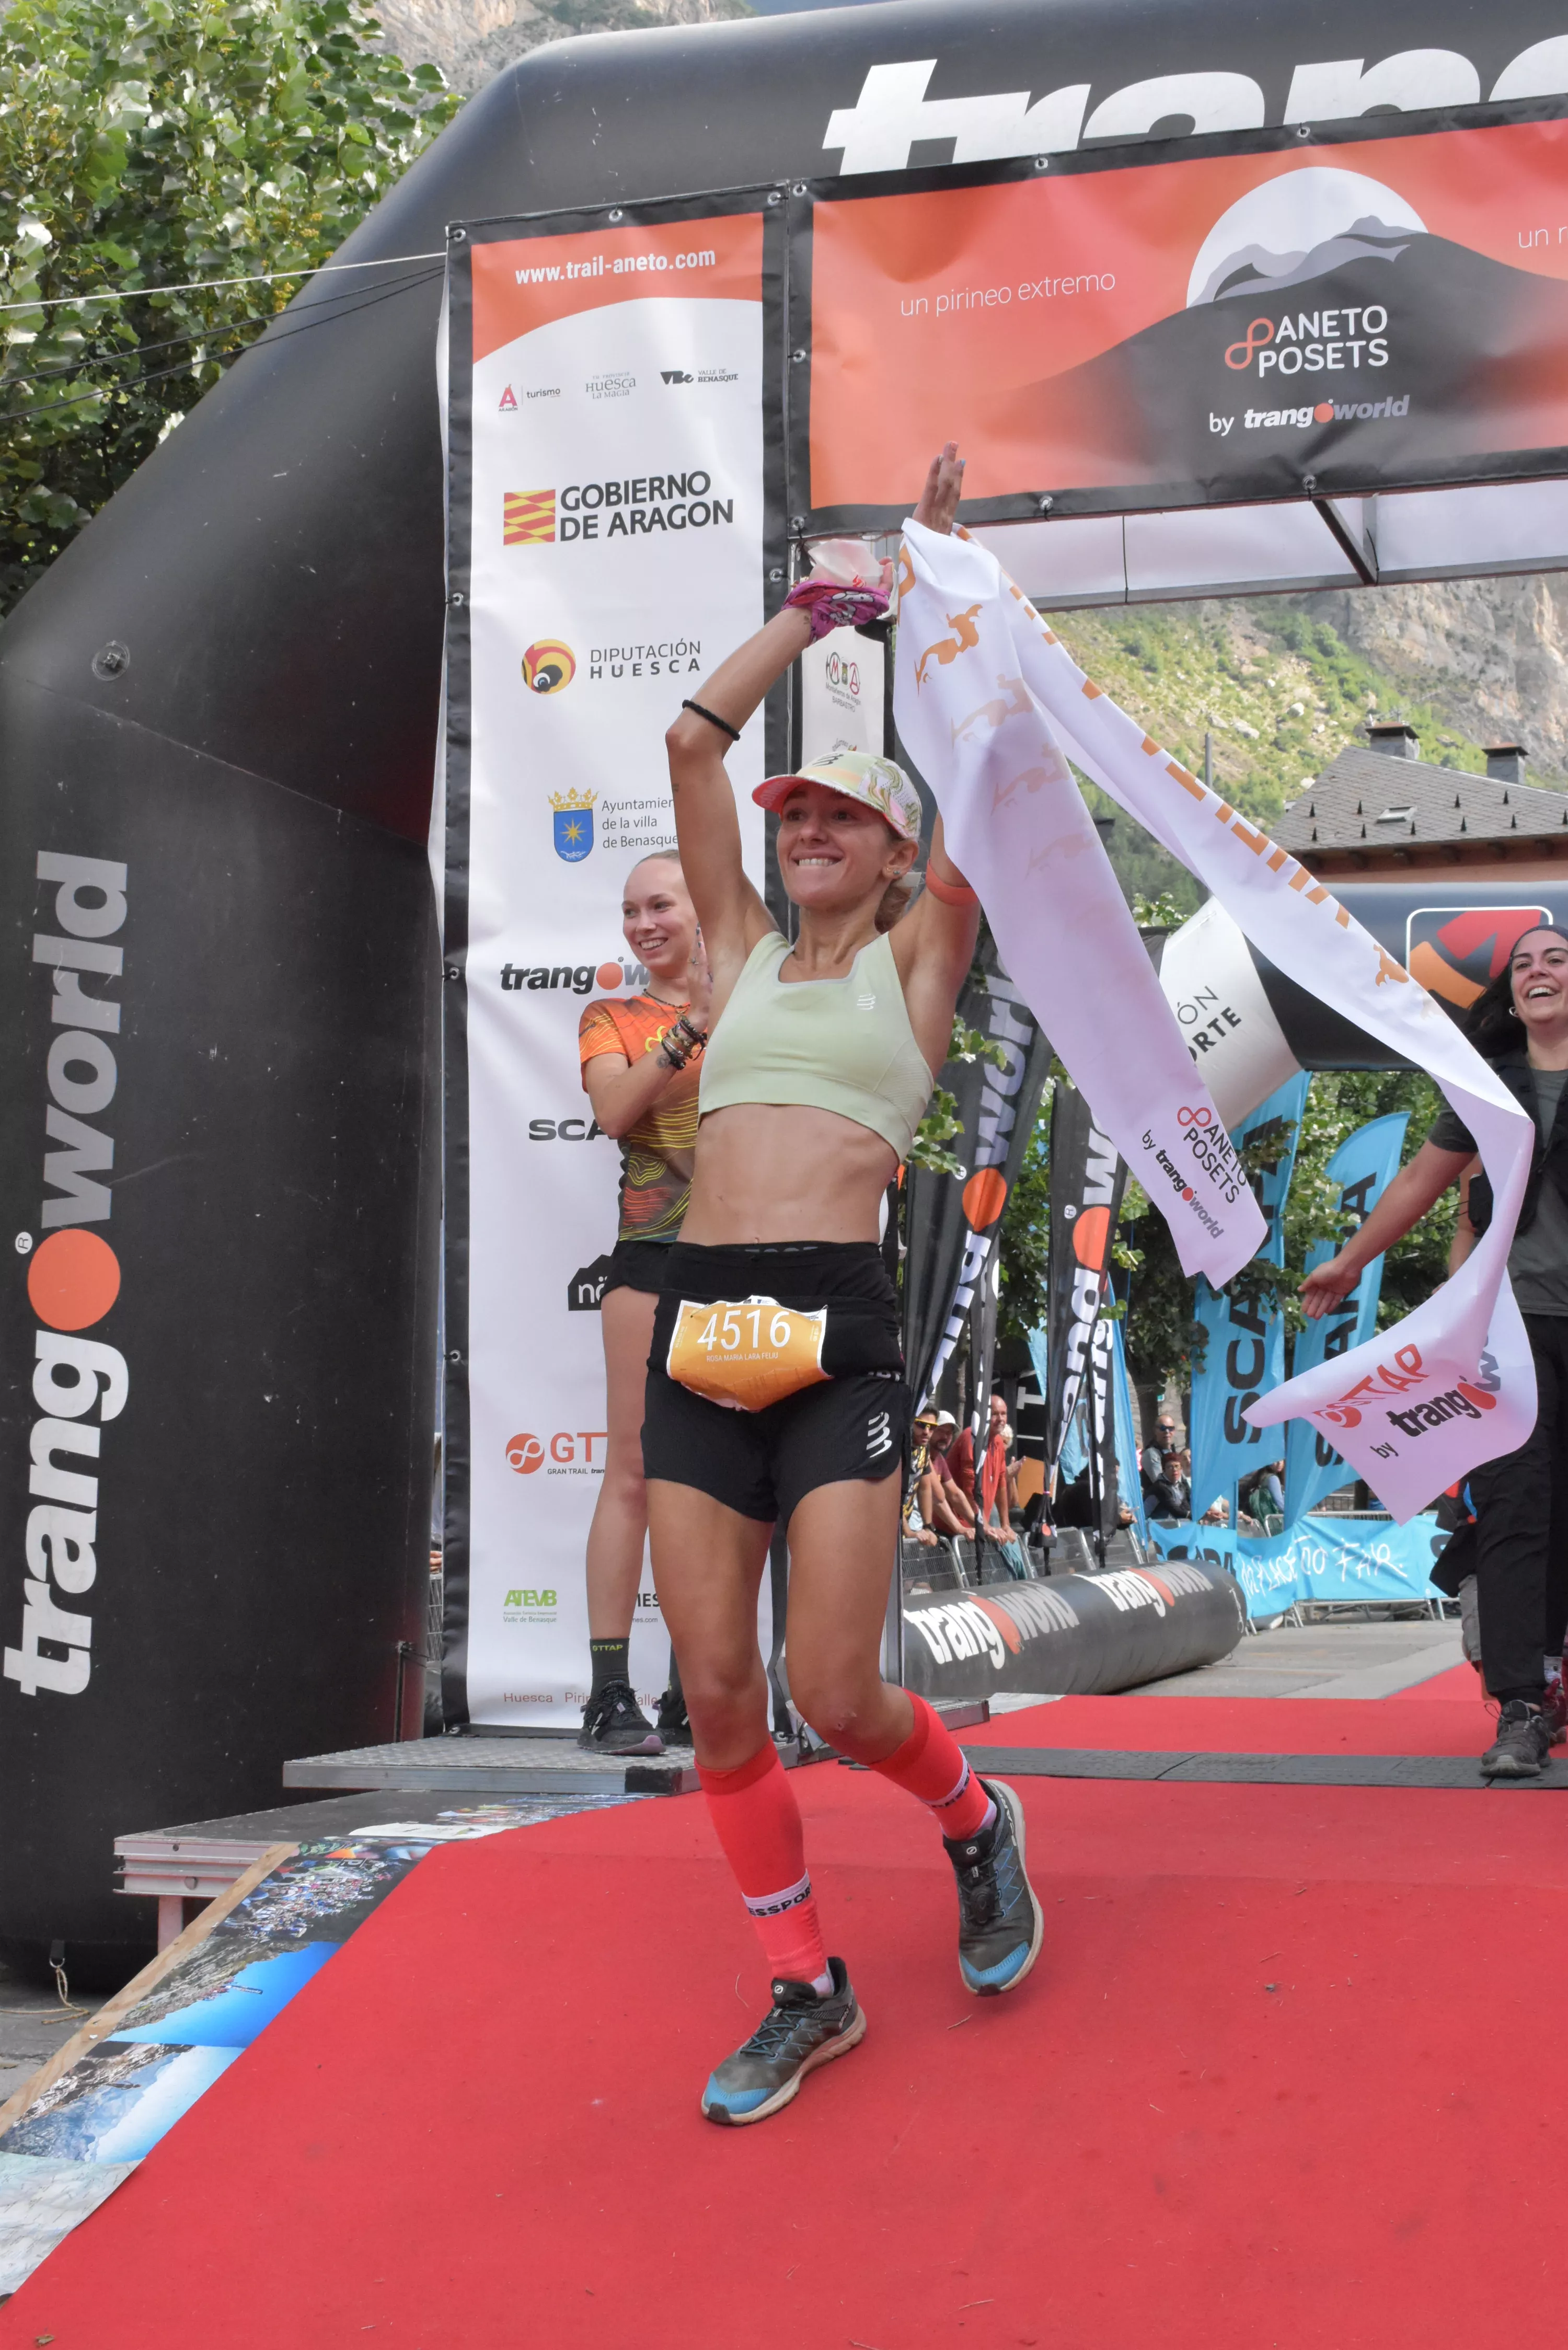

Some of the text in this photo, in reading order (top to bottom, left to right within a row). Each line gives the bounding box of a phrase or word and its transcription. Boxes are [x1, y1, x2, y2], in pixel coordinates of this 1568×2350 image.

[1518, 226, 1568, 248] un r
[515, 249, 716, 284] www.trail-aneto.com
[901, 273, 1115, 317] un pirineo extremo
[1275, 305, 1388, 344] ANETO
[1259, 339, 1389, 377] POSETS
[698, 374, 739, 383] BENASQUE
[526, 387, 561, 398] turismo
[1209, 412, 1235, 436] by
[560, 471, 711, 511] GOBIERNO
[560, 518, 598, 542] DE
[590, 638, 701, 663] DIPUTACIÓN
[590, 658, 700, 679] HUESCA
[602, 815, 658, 830] de la villa
[603, 835, 678, 848] de Benasque
[1177, 985, 1219, 1024] ÓN
[1142, 1129, 1156, 1150] by
[1183, 1127, 1239, 1203] POSETS
[697, 1309, 791, 1351] 4516
[1369, 1442, 1399, 1459] by
[503, 1589, 557, 1607] ATEVB
[504, 1692, 553, 1703] Huesca
[633, 1694, 658, 1706] alle
